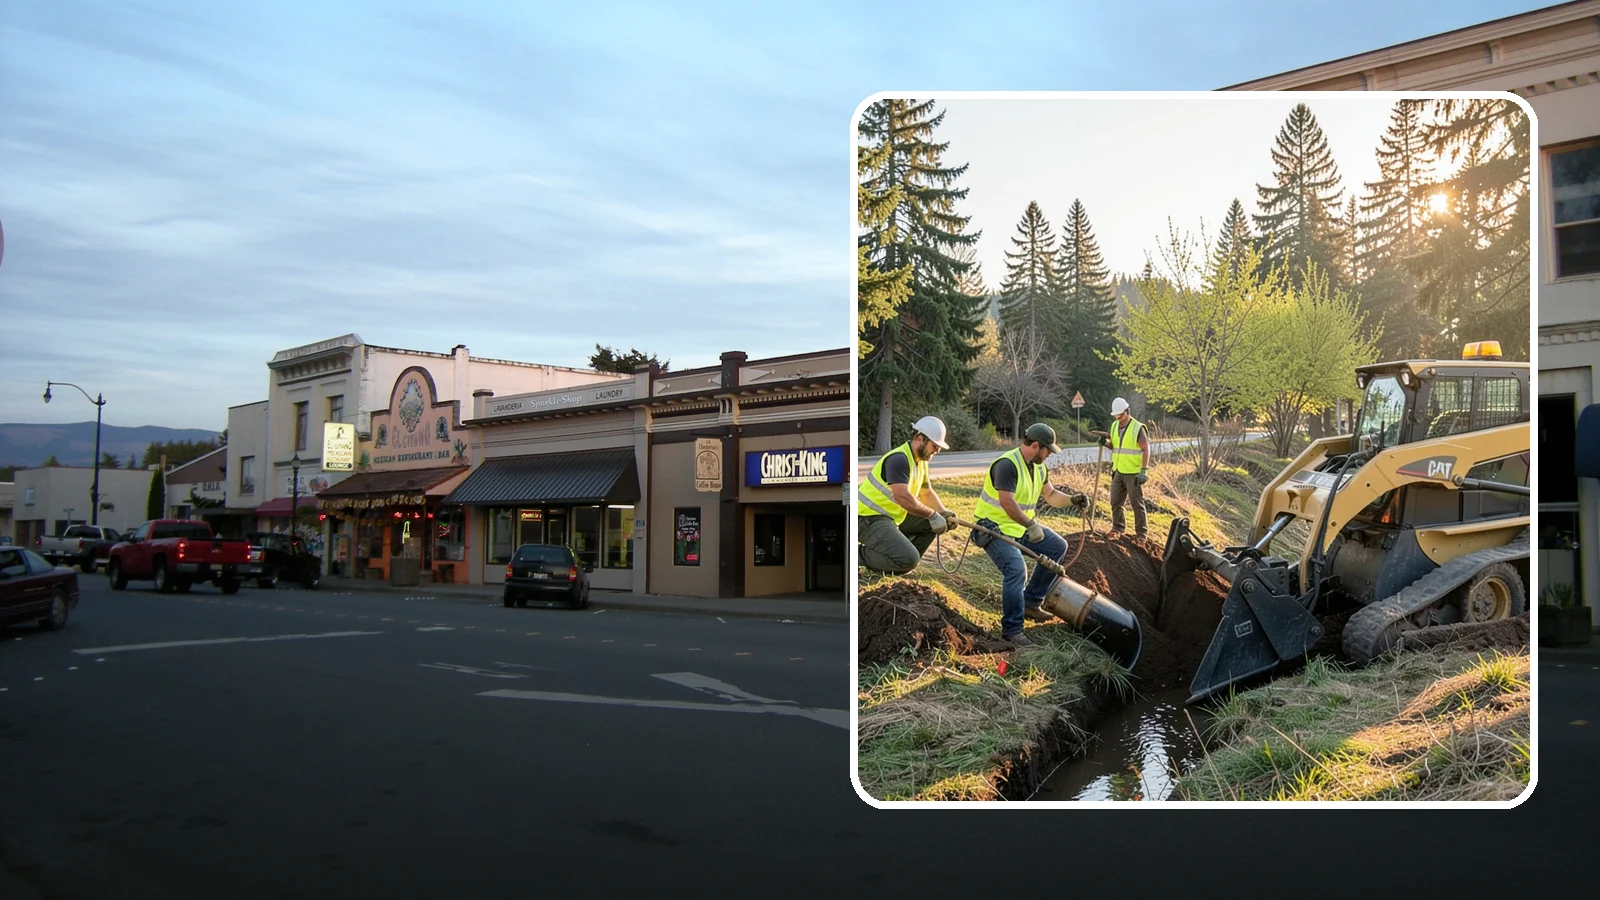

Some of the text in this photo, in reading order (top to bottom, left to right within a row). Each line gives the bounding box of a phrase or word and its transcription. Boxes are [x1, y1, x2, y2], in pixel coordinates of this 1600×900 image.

[562, 394, 582, 405] Shop
[596, 389, 623, 399] LAUNDRY
[494, 402, 522, 412] LAVANDERIA
[374, 454, 396, 463] MEXICAN
[398, 451, 433, 462] RESTAURANT
[438, 450, 449, 458] BAR
[1428, 460, 1452, 479] CAT
